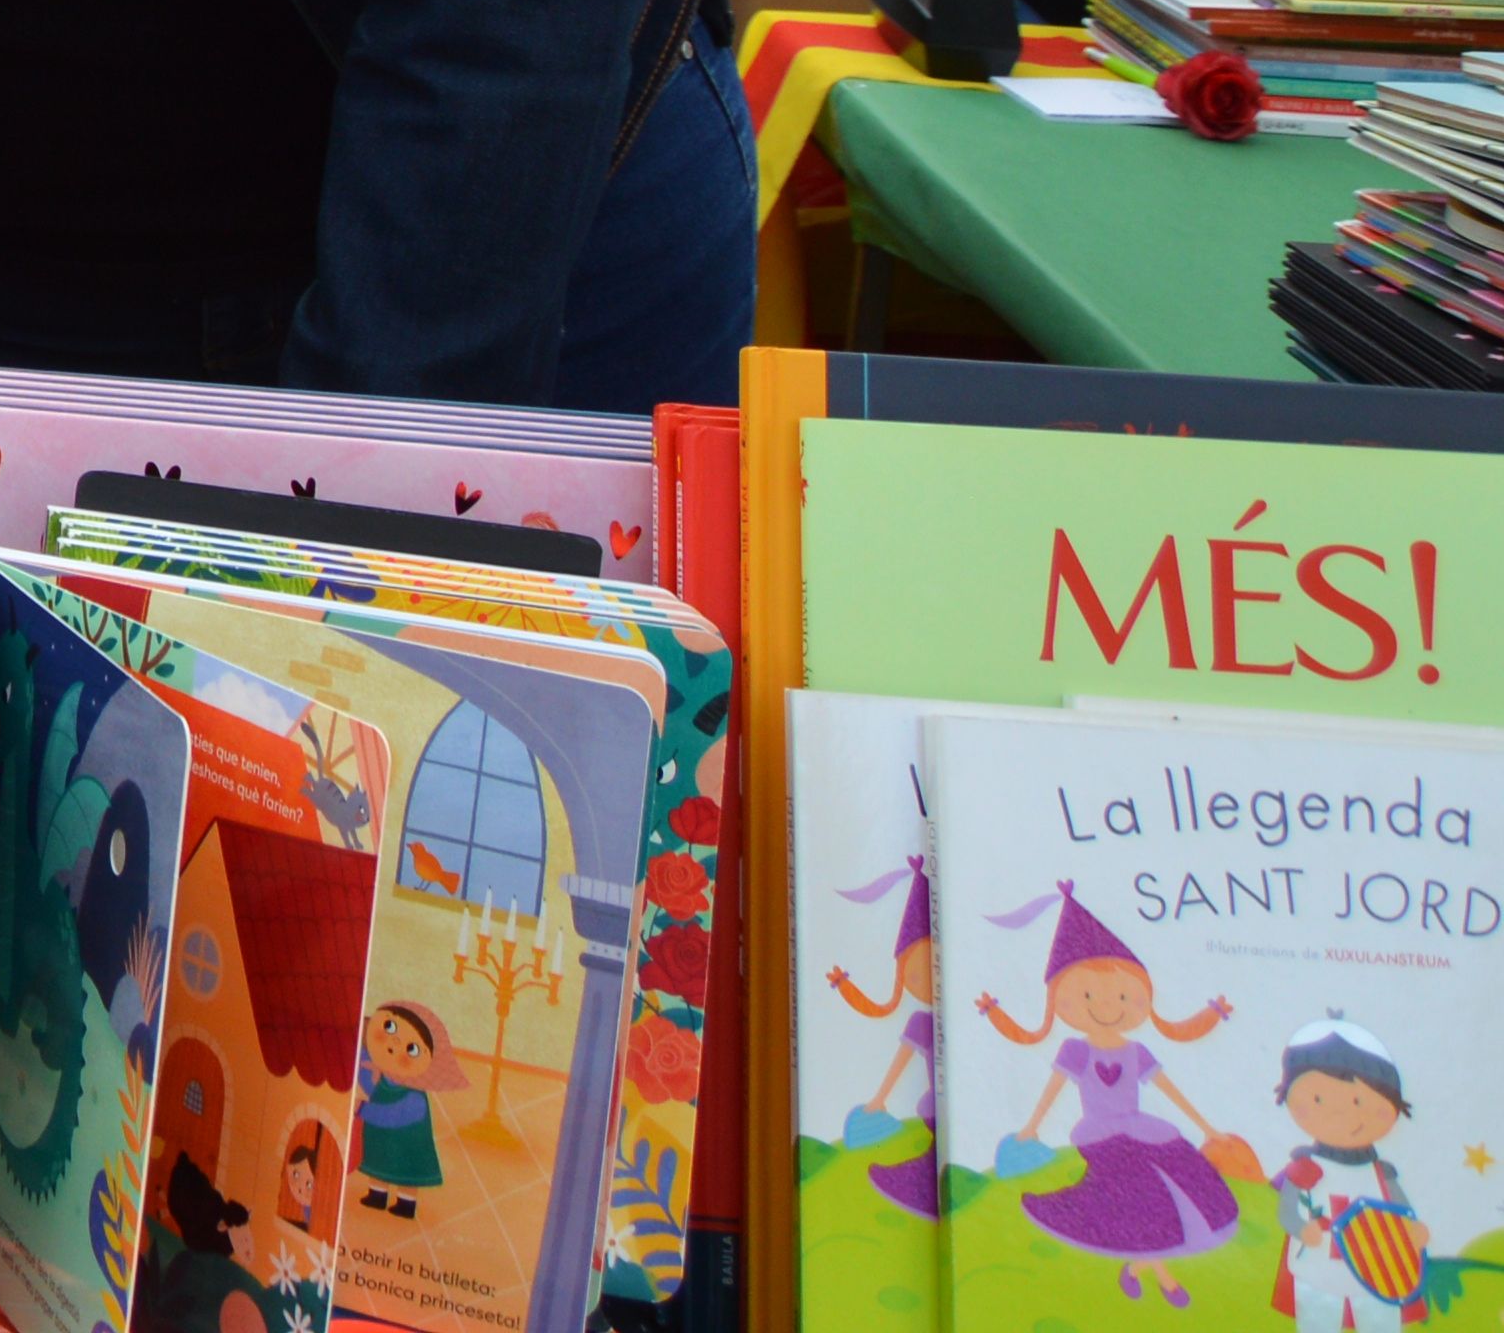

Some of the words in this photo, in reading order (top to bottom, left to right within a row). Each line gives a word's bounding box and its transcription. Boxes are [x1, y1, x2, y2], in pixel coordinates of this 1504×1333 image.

[1039, 498, 1441, 686] MÉS!
[216, 745, 240, 766] que
[240, 754, 282, 788] tenien,
[237, 782, 261, 805] què
[261, 792, 305, 824] farien?
[1056, 782, 1142, 846] La
[1163, 764, 1474, 850] llegenda
[1134, 866, 1306, 923] SANT
[350, 1247, 394, 1270] obrir
[397, 1256, 414, 1275] la
[418, 1259, 497, 1298] butlleta:
[354, 1271, 416, 1302] bonica
[419, 1292, 522, 1331] princeseta!
